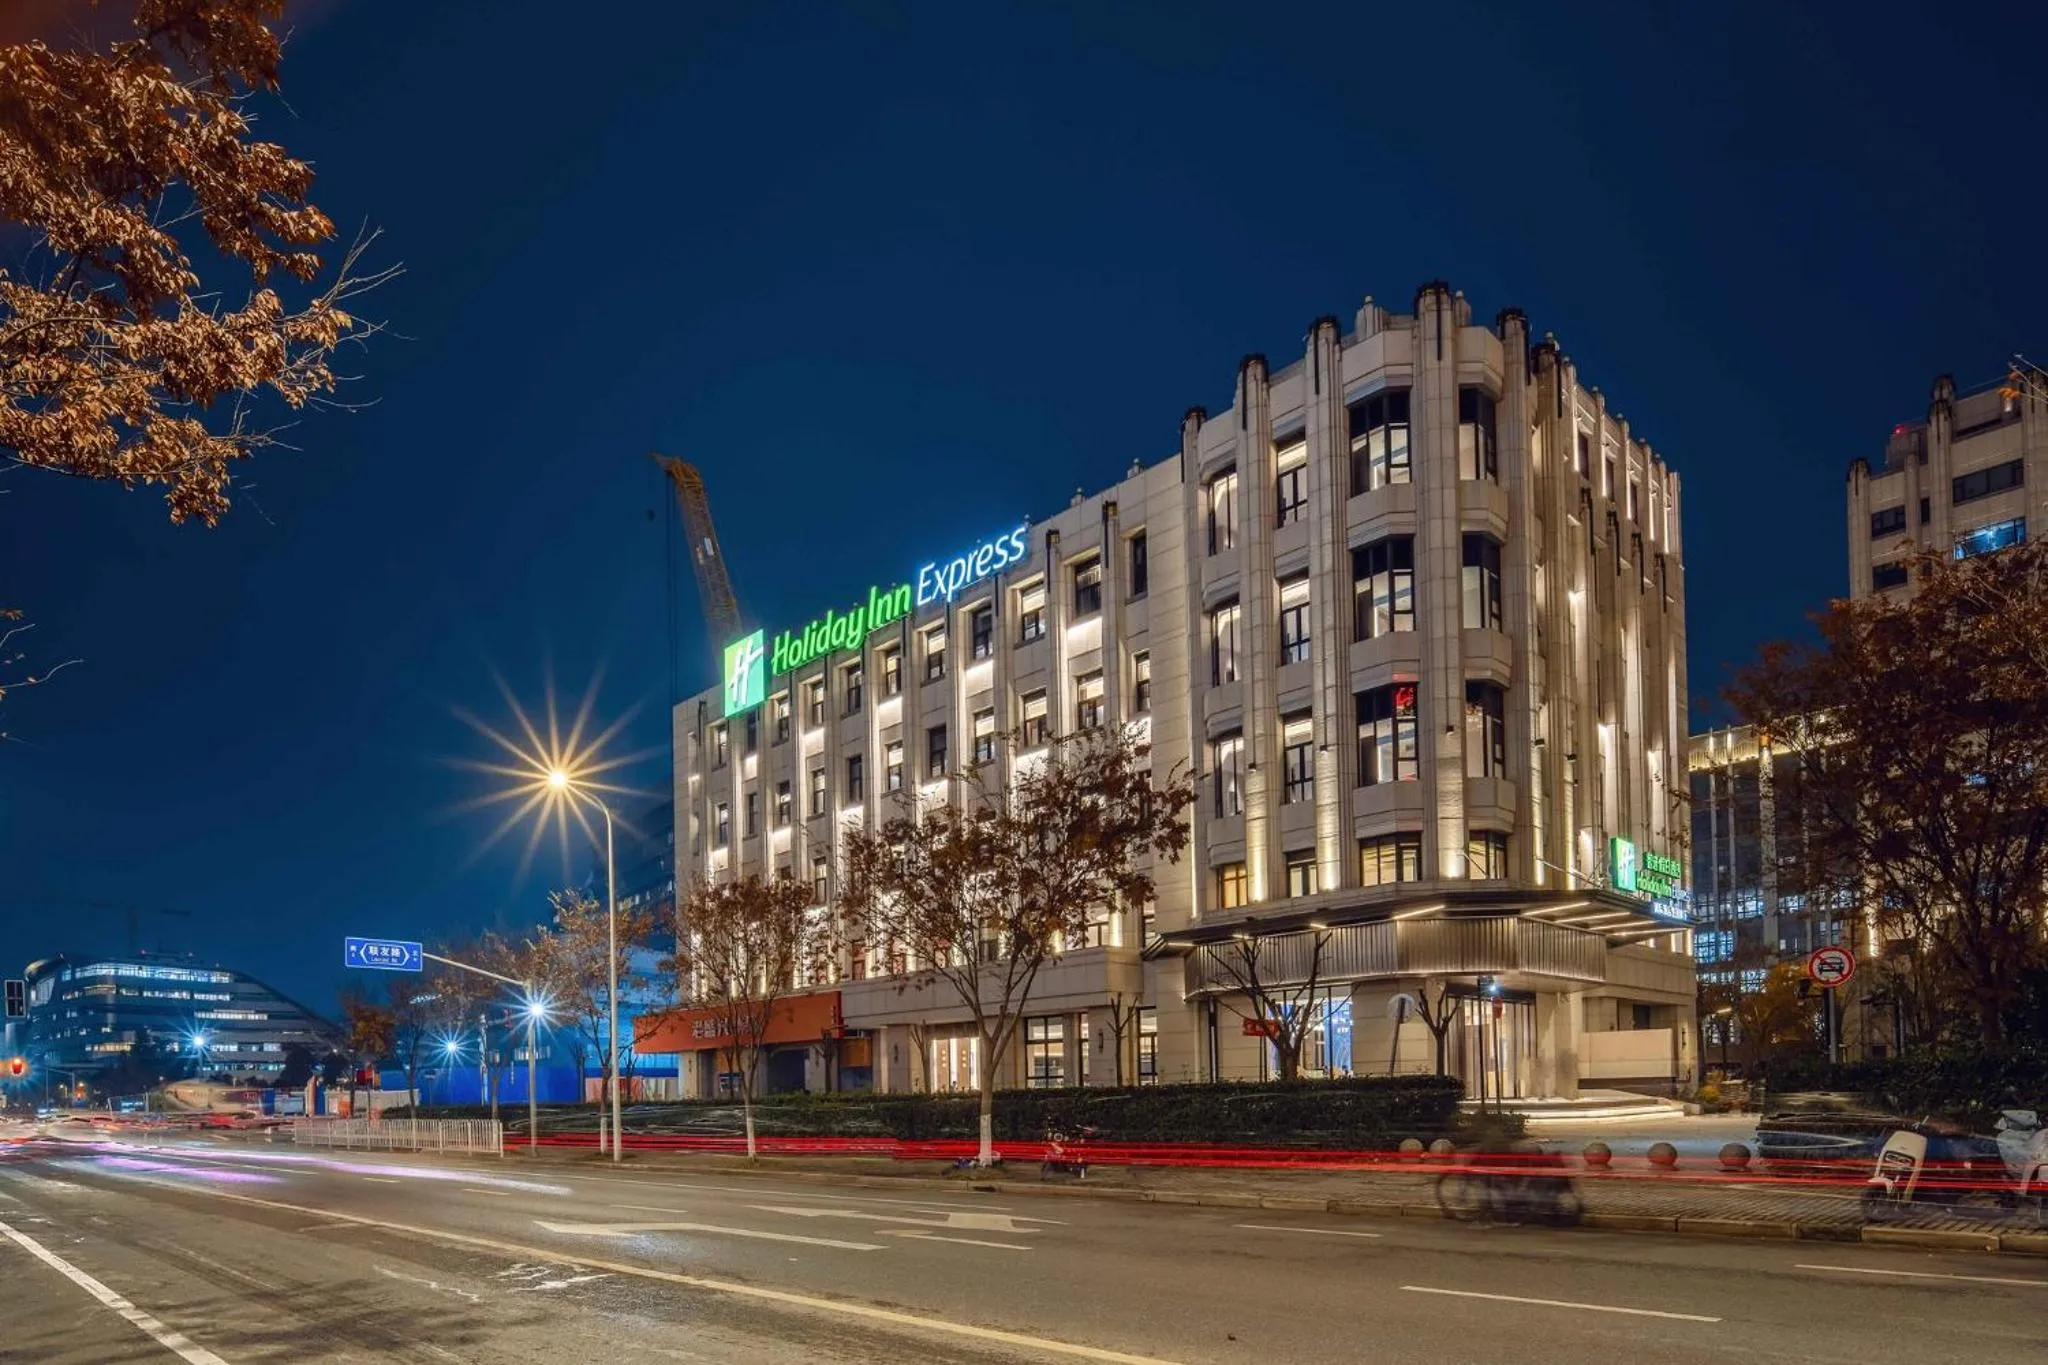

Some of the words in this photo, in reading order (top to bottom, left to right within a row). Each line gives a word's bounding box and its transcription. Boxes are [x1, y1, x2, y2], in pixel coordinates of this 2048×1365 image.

[770, 605, 865, 675] Holiday
[867, 584, 912, 629] Inn
[916, 527, 1027, 606] Express
